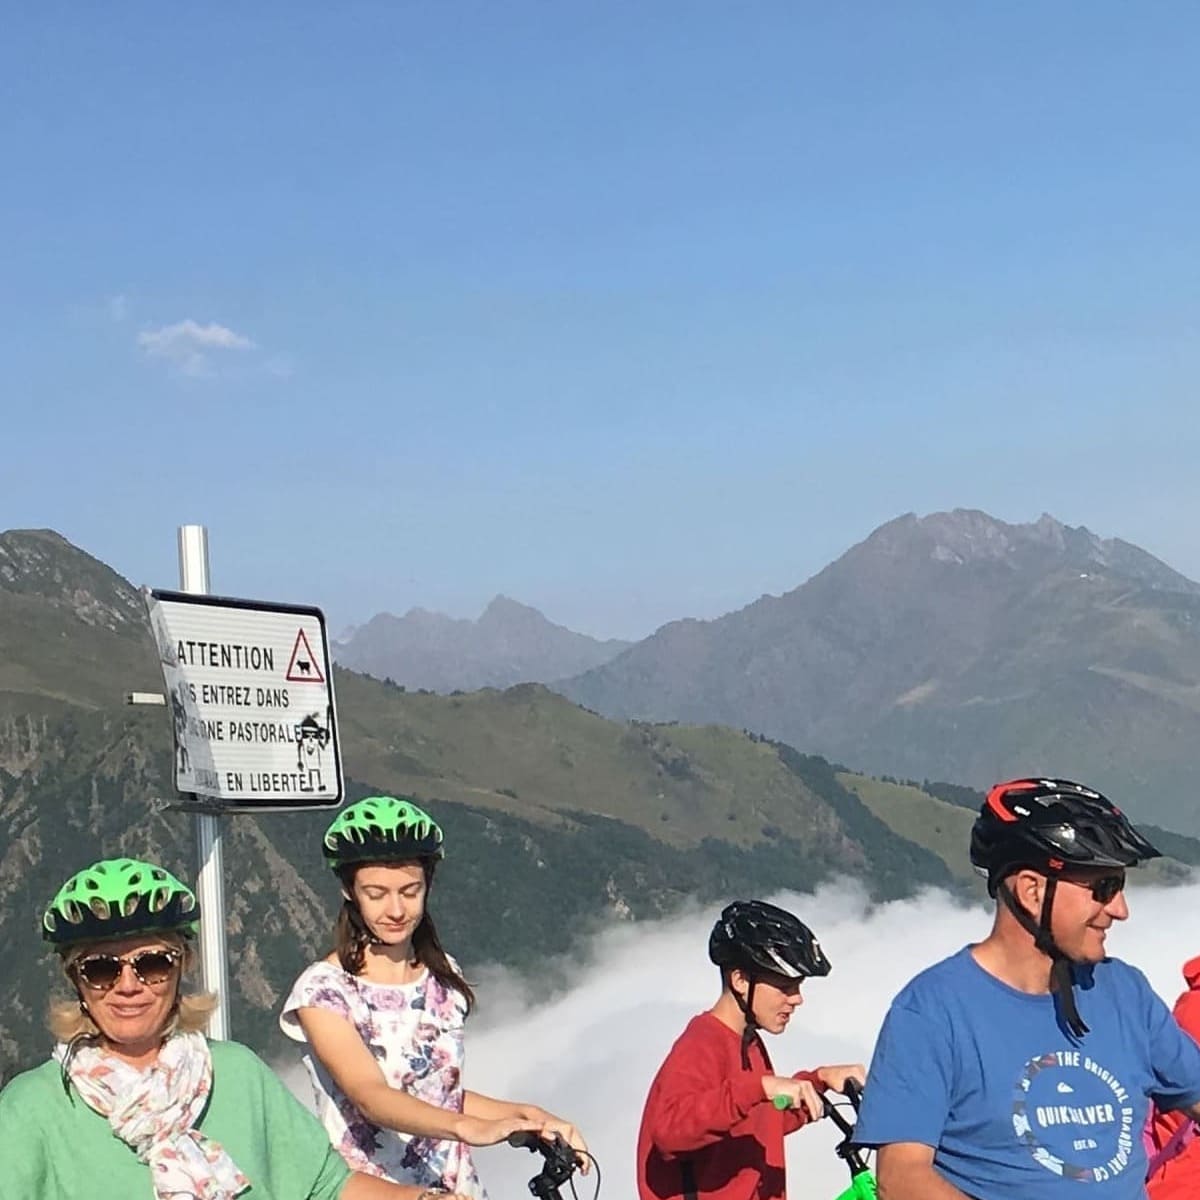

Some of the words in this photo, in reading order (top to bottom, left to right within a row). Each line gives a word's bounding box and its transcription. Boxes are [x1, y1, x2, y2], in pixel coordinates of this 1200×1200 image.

[177, 640, 274, 671] ATTENTION
[202, 684, 251, 706] ENTREZ
[256, 687, 290, 708] DANS
[229, 721, 303, 744] PASTORALE
[226, 772, 243, 792] EN
[1055, 1050, 1081, 1067] THE
[1084, 1056, 1130, 1104] ORIGINAL
